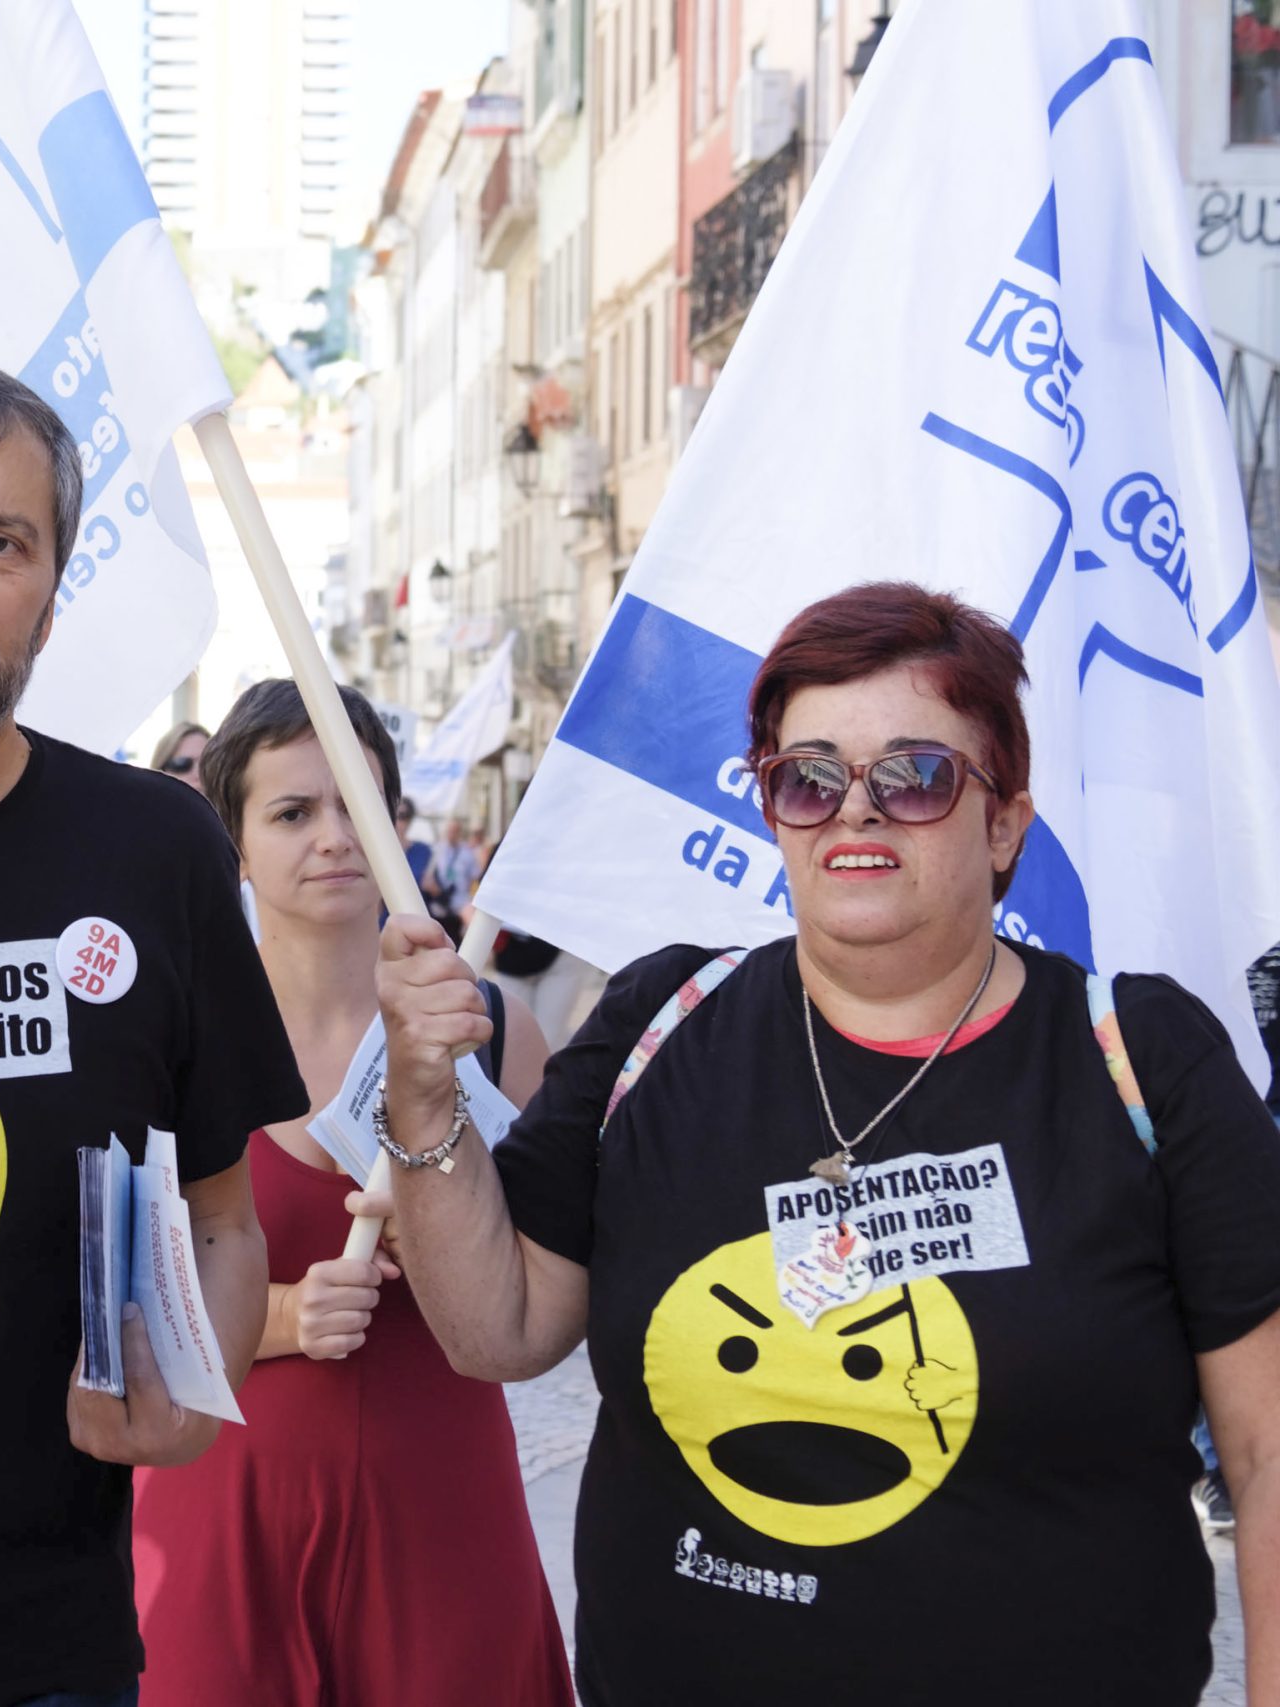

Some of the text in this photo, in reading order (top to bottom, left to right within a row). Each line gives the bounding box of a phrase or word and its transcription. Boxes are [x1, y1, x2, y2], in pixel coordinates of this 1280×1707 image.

[682, 824, 750, 889] da
[88, 923, 121, 956] 9A
[76, 945, 117, 978] 4M
[68, 965, 105, 996] 2D
[358, 1069, 383, 1110] PORTUGAL
[777, 1157, 1000, 1224] APOSENTAÇÃO?
[913, 1197, 973, 1230] não
[910, 1232, 974, 1266] ser!
